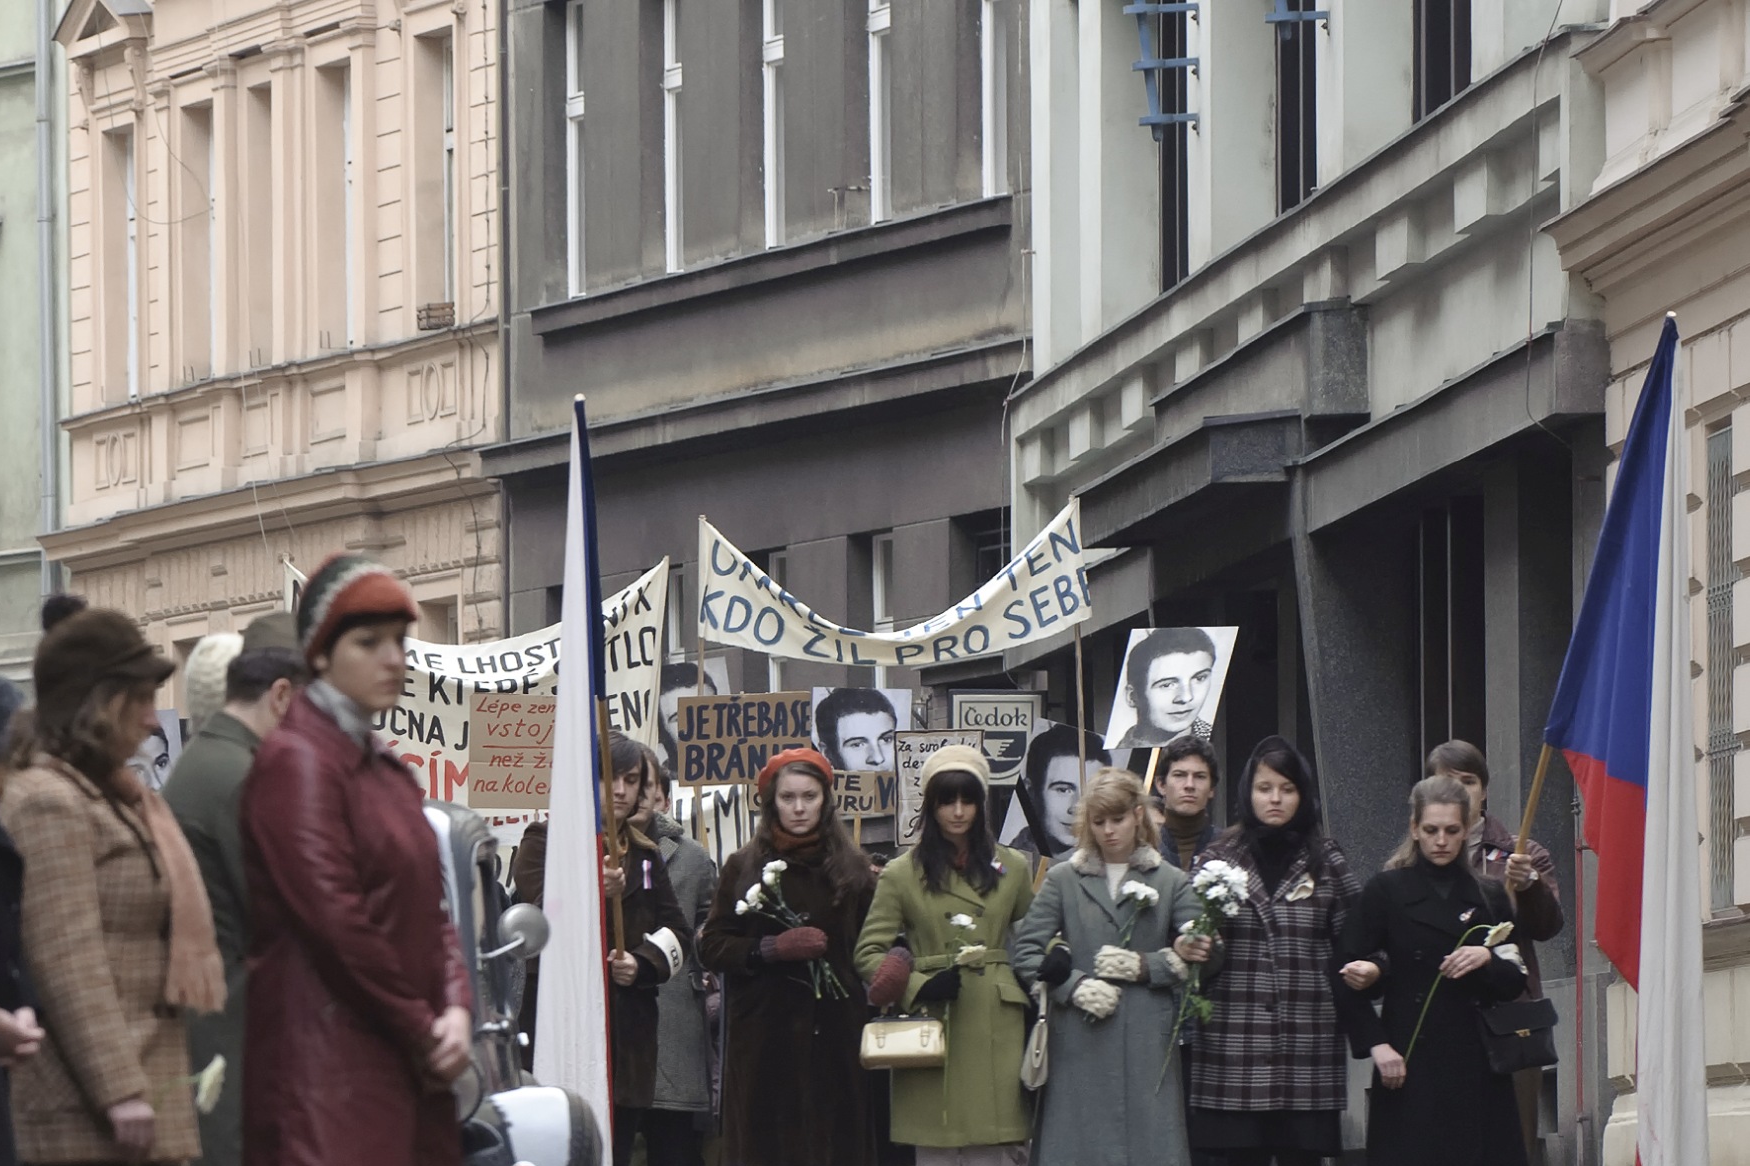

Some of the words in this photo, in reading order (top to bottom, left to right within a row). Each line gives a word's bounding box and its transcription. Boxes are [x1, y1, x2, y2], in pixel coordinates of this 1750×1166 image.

[996, 518, 1081, 592] TEN
[700, 585, 785, 646] KDO
[802, 624, 877, 665] ŽIL
[894, 624, 990, 665] PRO
[476, 696, 522, 719] Lépe
[678, 705, 710, 742] JE
[712, 696, 790, 739] TŘEBA
[790, 700, 812, 738] SE
[963, 704, 1029, 728] Čedok
[489, 752, 524, 768] než
[473, 778, 498, 793] na
[501, 772, 552, 795] kole
